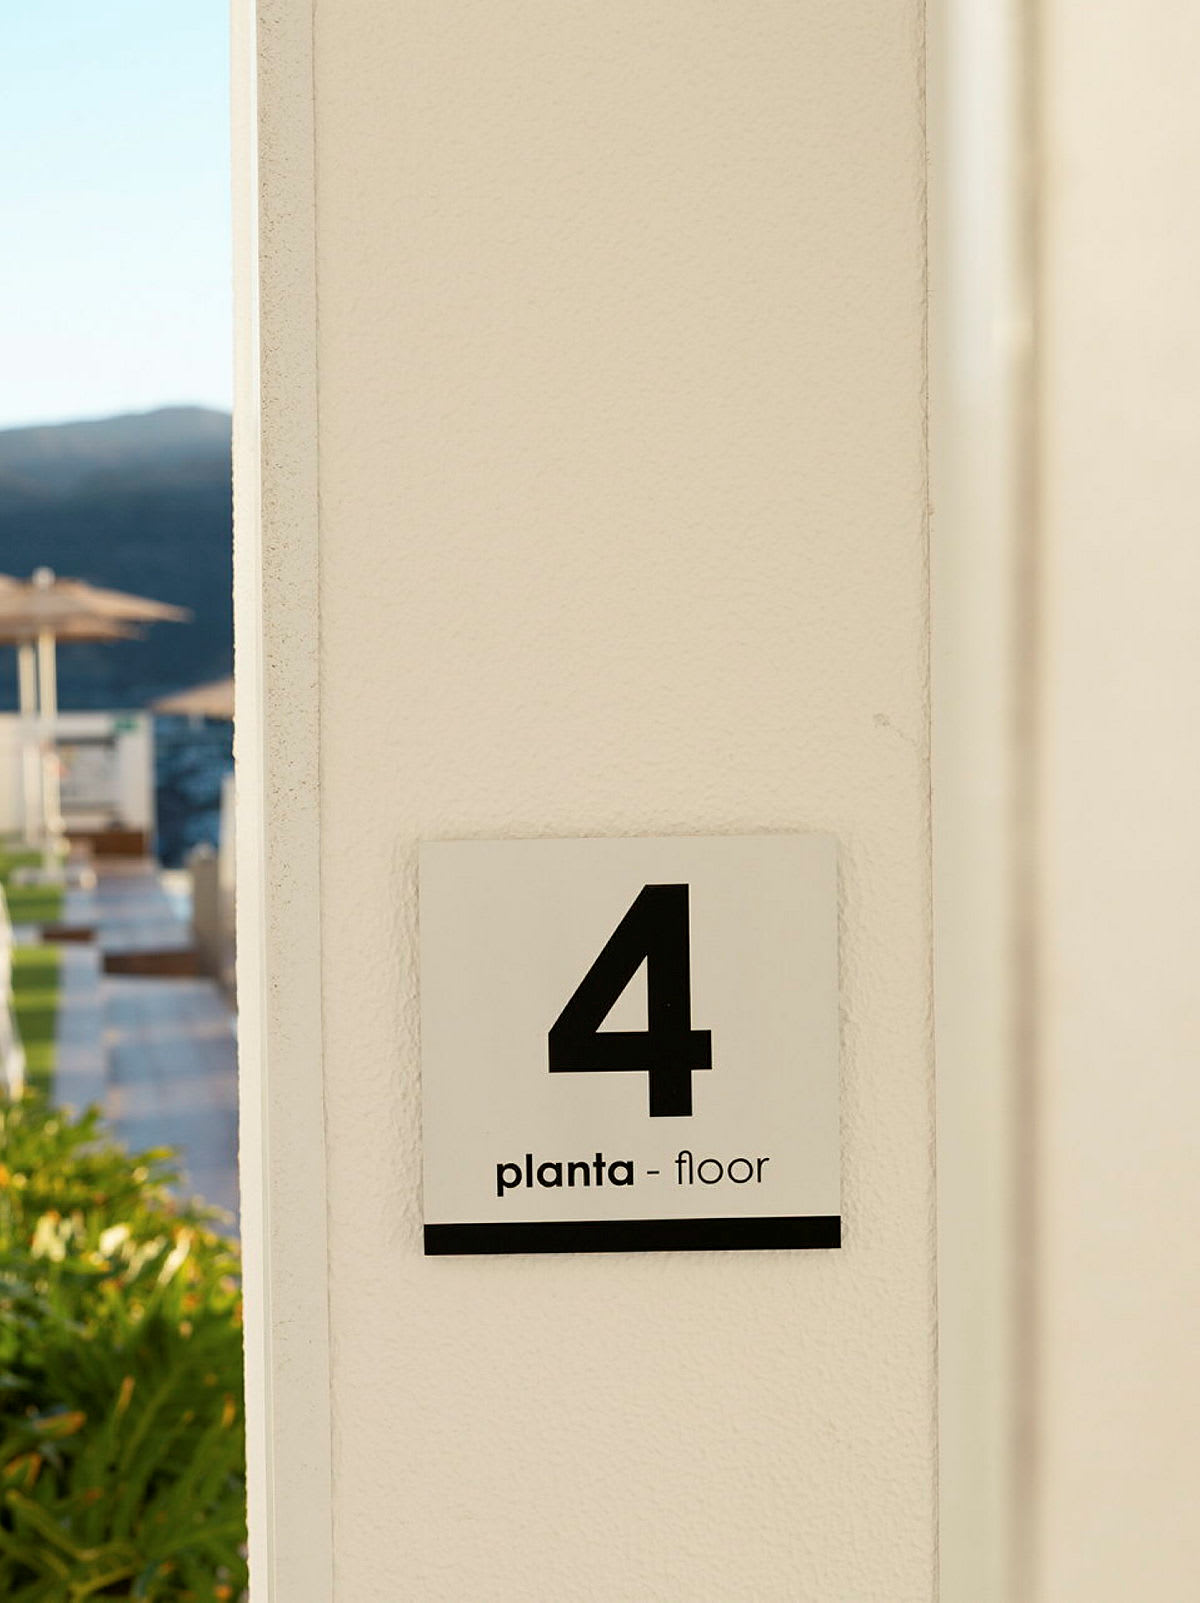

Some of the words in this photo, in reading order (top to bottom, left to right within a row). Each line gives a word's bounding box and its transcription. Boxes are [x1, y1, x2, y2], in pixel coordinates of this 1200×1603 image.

[548, 883, 713, 1117] 4
[496, 1152, 634, 1197] planta
[674, 1149, 770, 1185] floor
